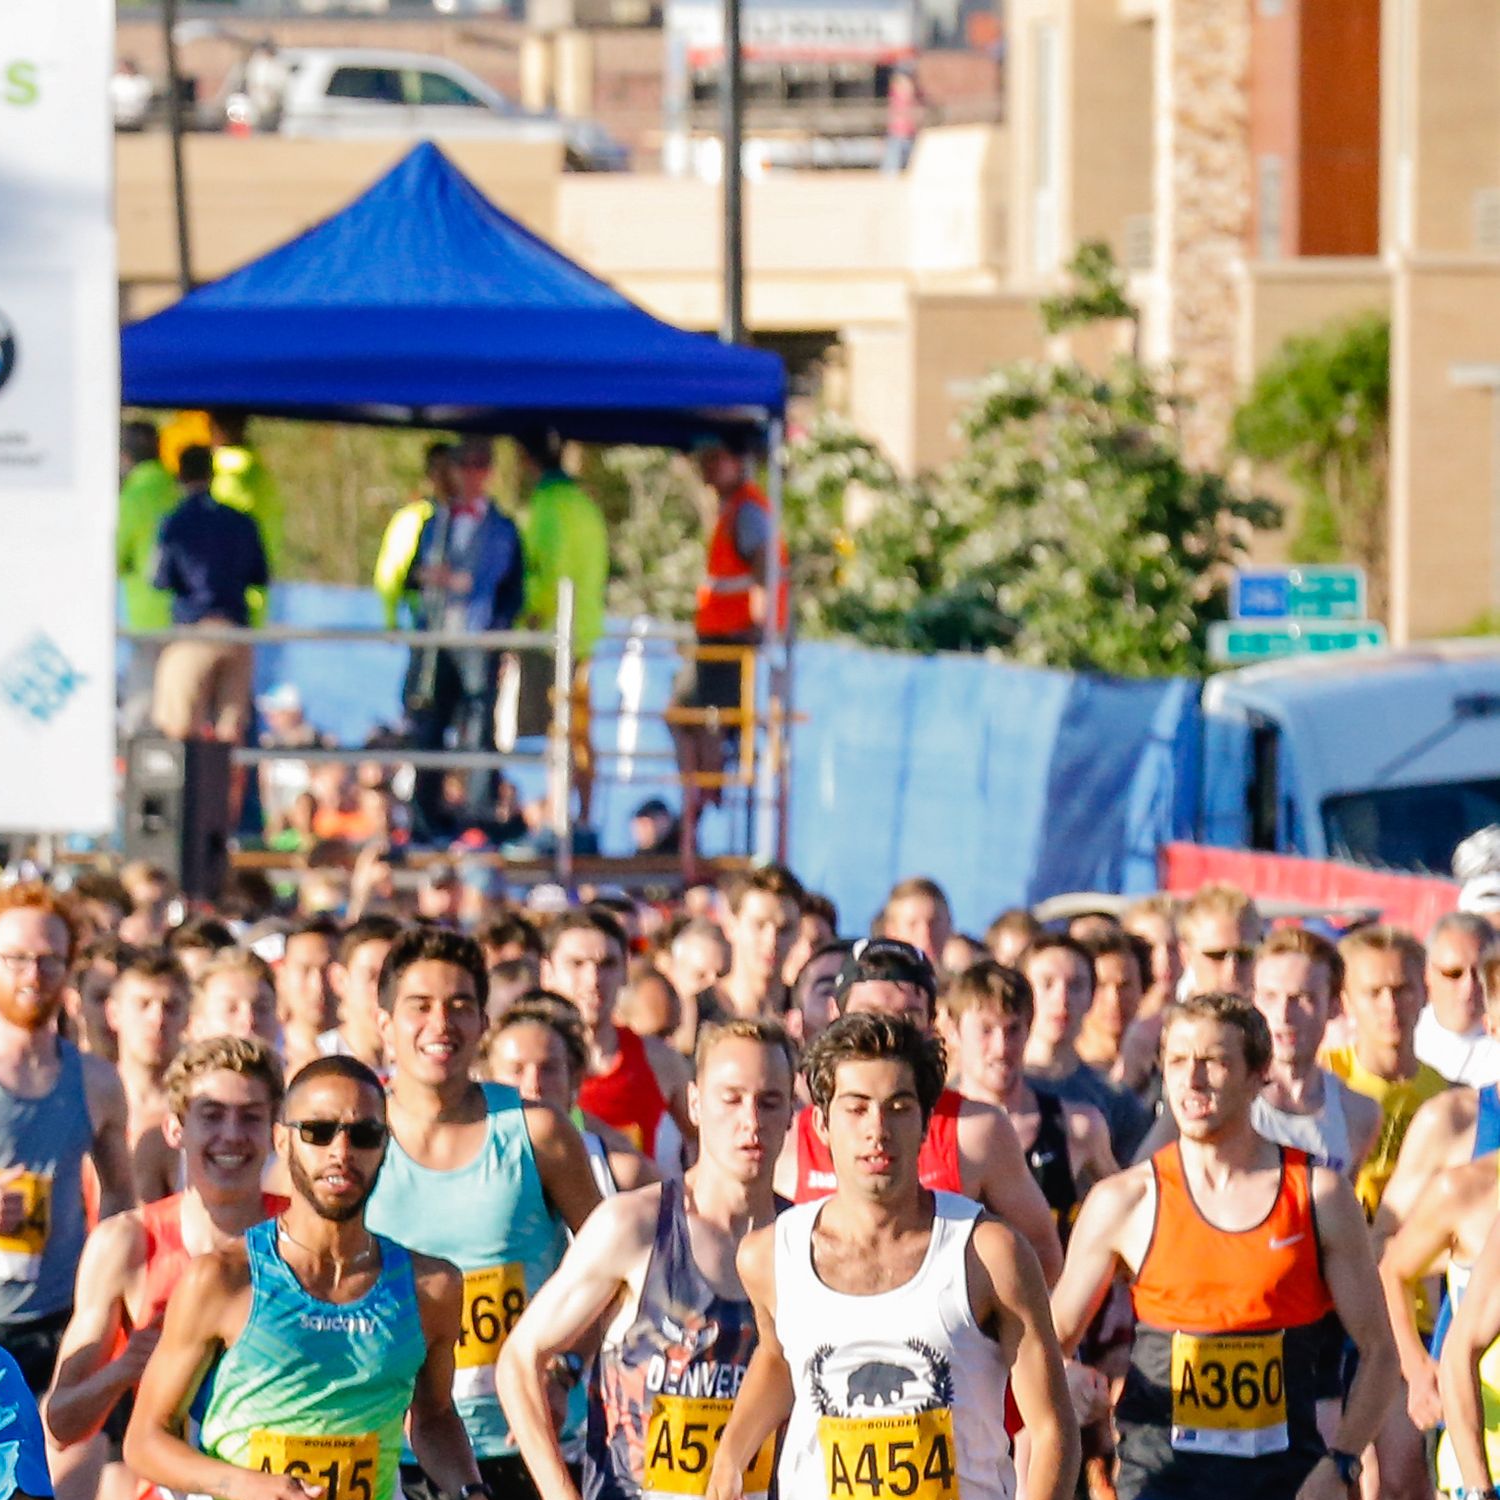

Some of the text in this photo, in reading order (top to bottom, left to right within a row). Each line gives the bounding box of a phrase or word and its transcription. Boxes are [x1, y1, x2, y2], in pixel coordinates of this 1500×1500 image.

[1178, 1357, 1283, 1410] A360
[650, 1419, 763, 1474] A5
[830, 1433, 955, 1498] A454
